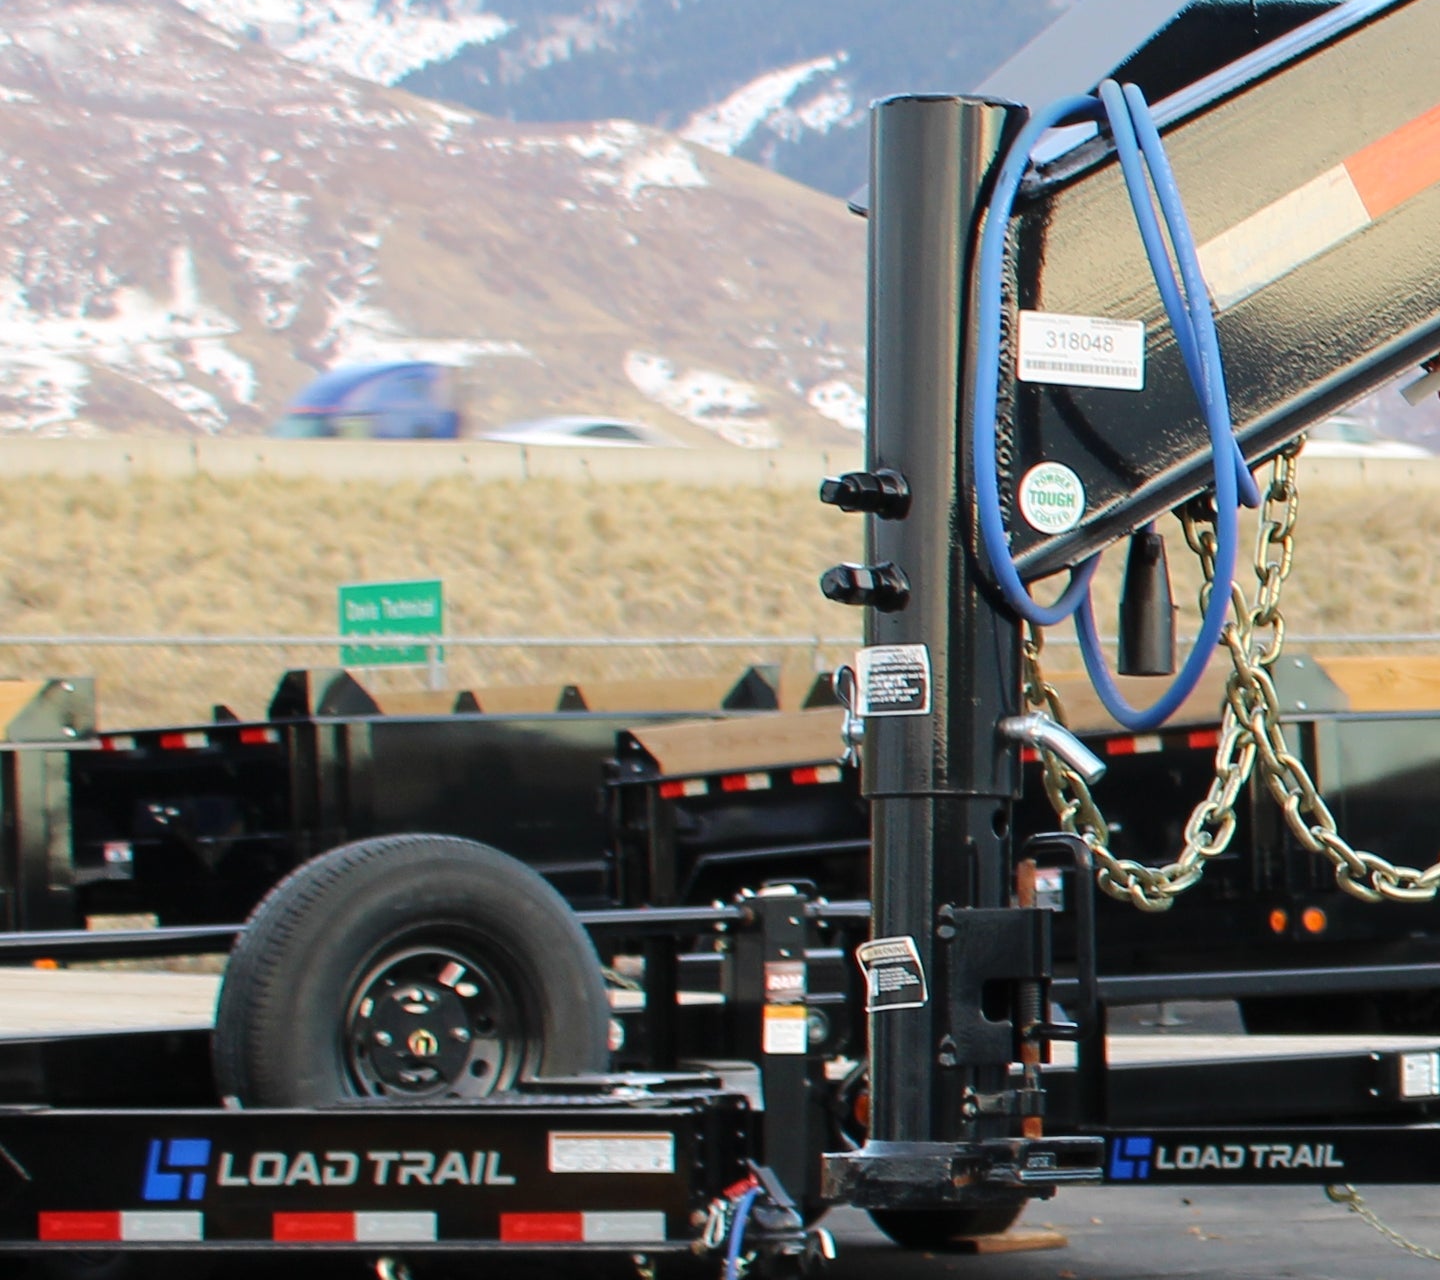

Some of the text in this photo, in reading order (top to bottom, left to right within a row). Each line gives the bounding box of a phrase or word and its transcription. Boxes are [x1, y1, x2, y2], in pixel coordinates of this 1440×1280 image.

[1046, 330, 1115, 353] 318048
[1028, 489, 1075, 508] TOUGH
[217, 1151, 360, 1187] LOAD
[366, 1150, 516, 1186] TRAIL
[1155, 1145, 1246, 1170] LOAD
[1249, 1143, 1344, 1169] TRAIL
